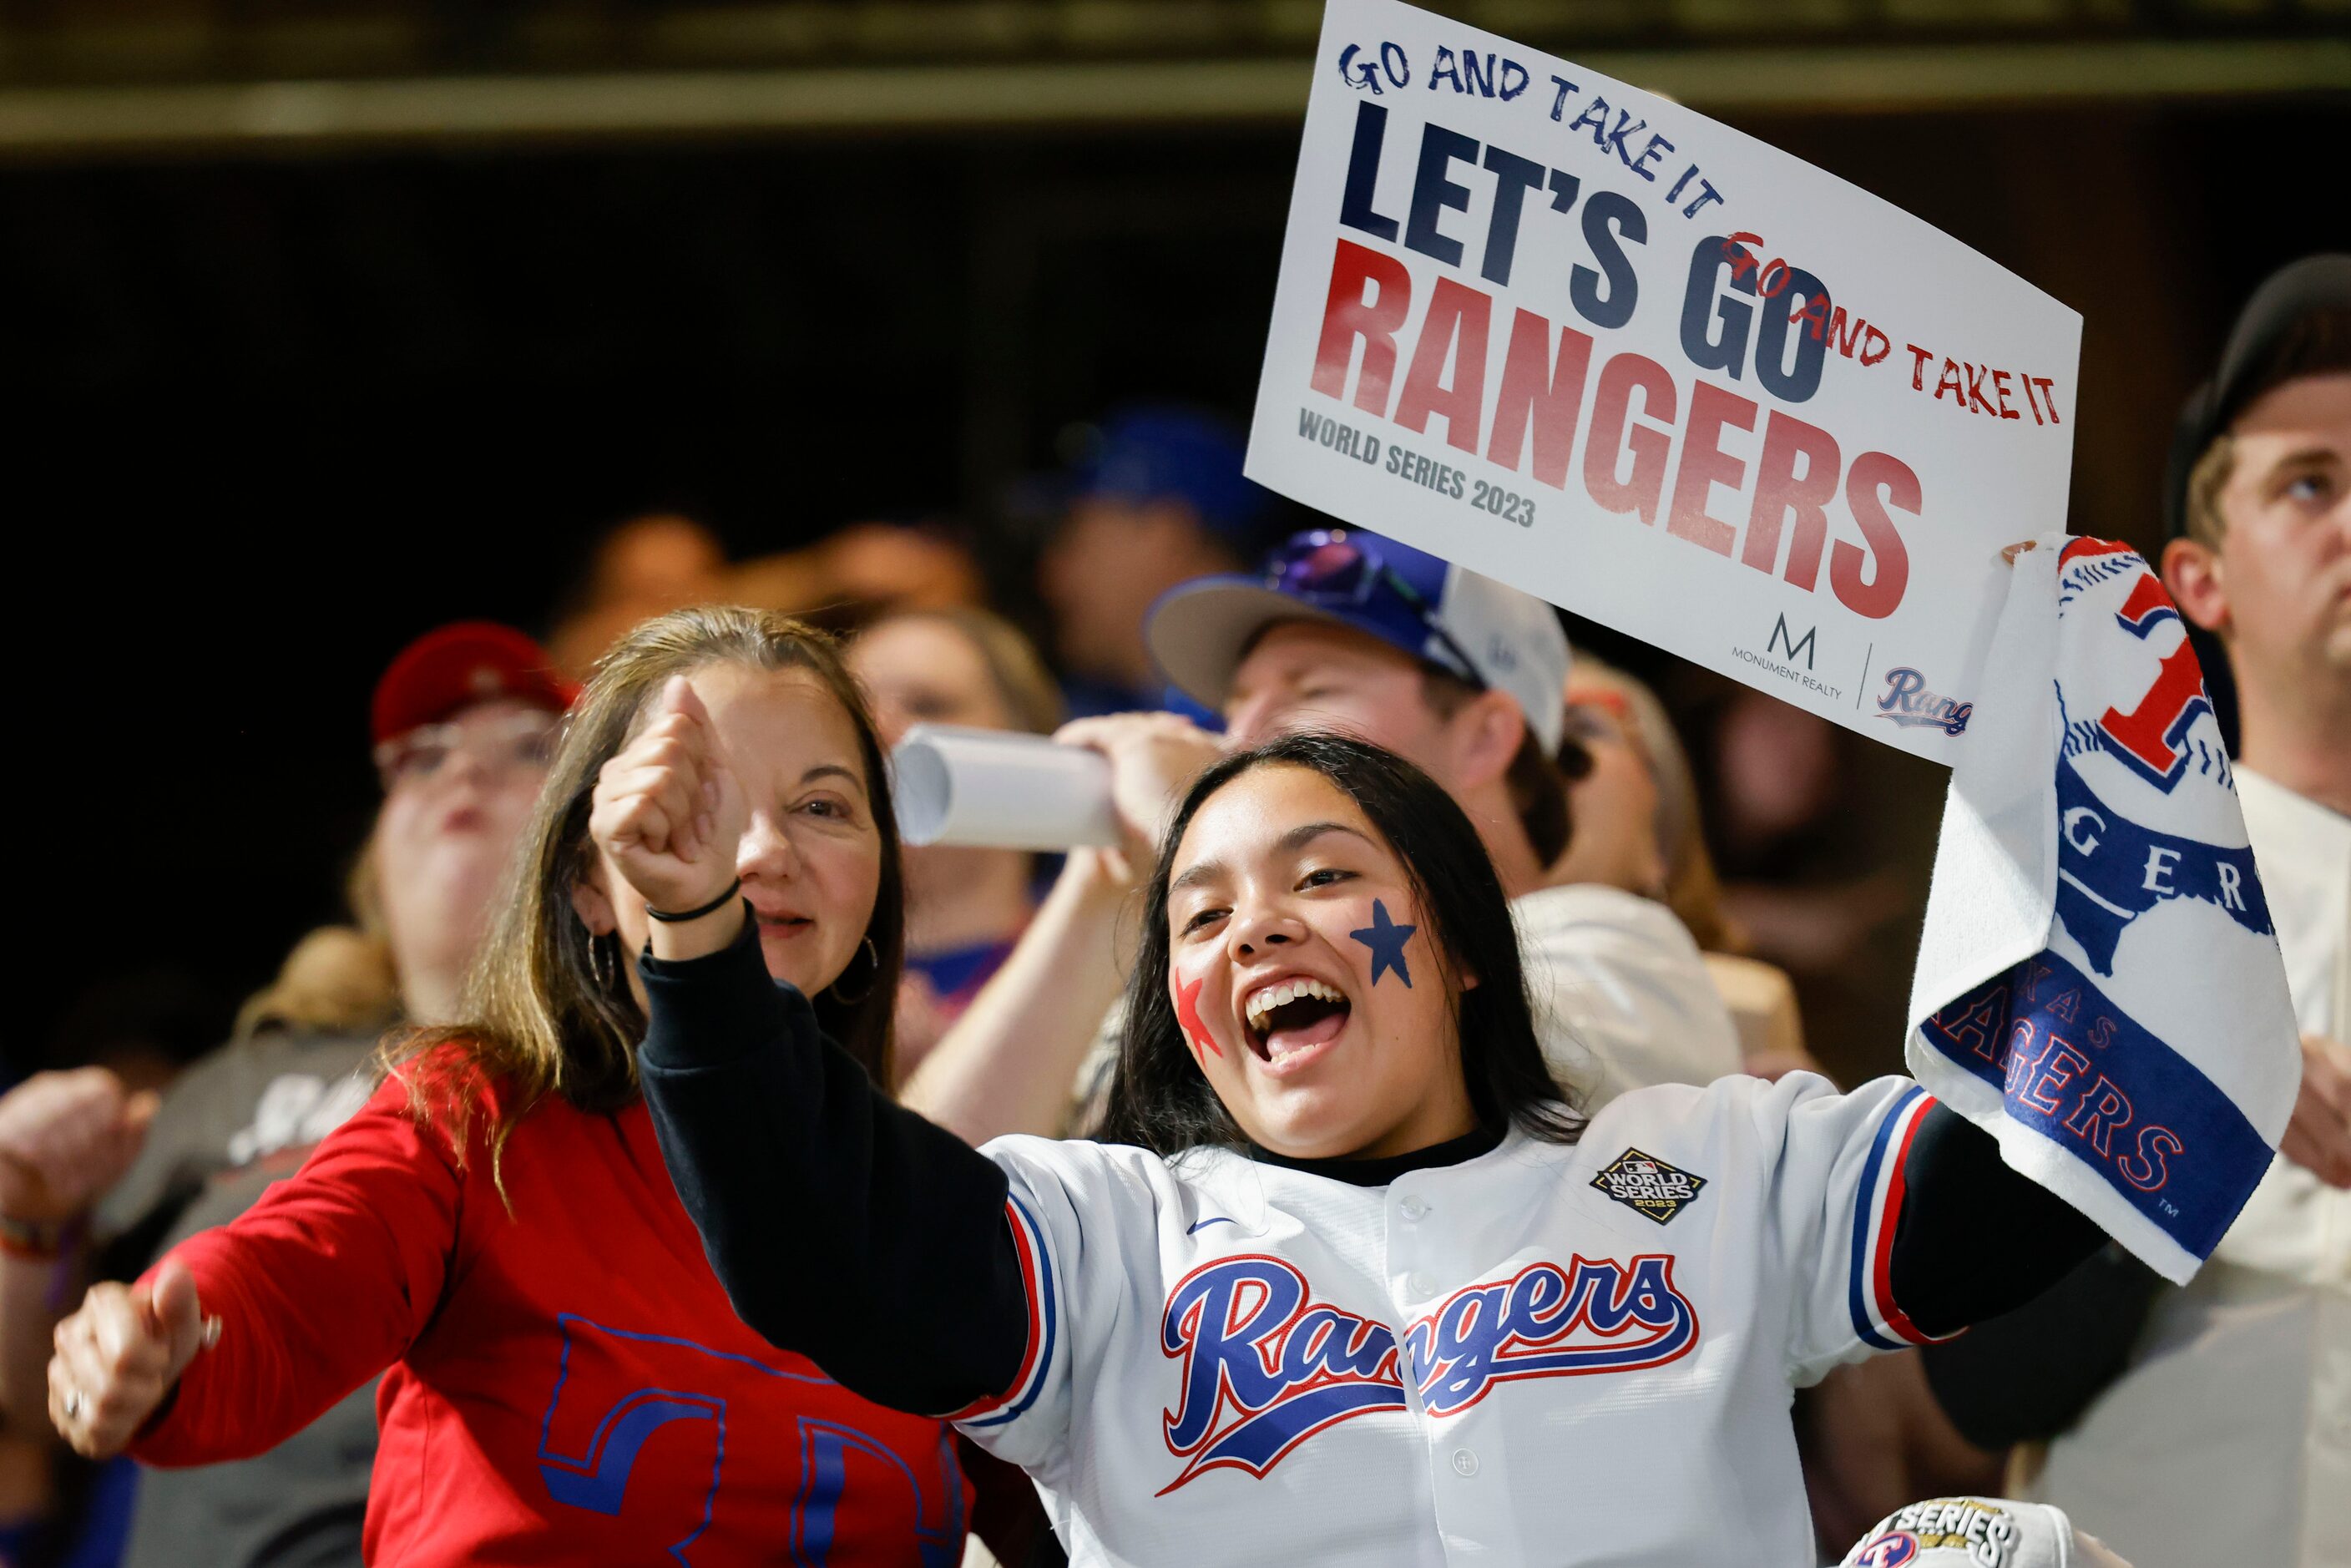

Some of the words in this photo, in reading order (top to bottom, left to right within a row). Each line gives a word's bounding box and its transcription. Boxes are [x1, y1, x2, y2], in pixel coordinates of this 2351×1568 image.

[1338, 42, 1410, 95] GO
[1428, 45, 1529, 101] AND
[1550, 75, 1675, 181] TAKE
[1666, 164, 1724, 219] IT
[1339, 100, 1647, 330] LET'S
[1680, 235, 1832, 403] GO
[1722, 231, 1792, 298] GO
[1788, 293, 1891, 367] AND
[1907, 343, 2020, 419] TAKE
[2020, 373, 2060, 426] IT
[1298, 407, 1379, 465] WORLD
[1386, 445, 1465, 500] SERIES
[1472, 479, 1537, 528] 2023
[1310, 237, 1923, 619] RANGERS
[1732, 646, 1800, 683] MONUMENT
[1802, 675, 1843, 701] REALTY
[1604, 1173, 1688, 1186] WORLD
[1610, 1185, 1694, 1200] SERIES
[1634, 1199, 1677, 1208] 2023
[1155, 1253, 1700, 1497] Rangers
[1894, 1502, 2020, 1568] SERIES
